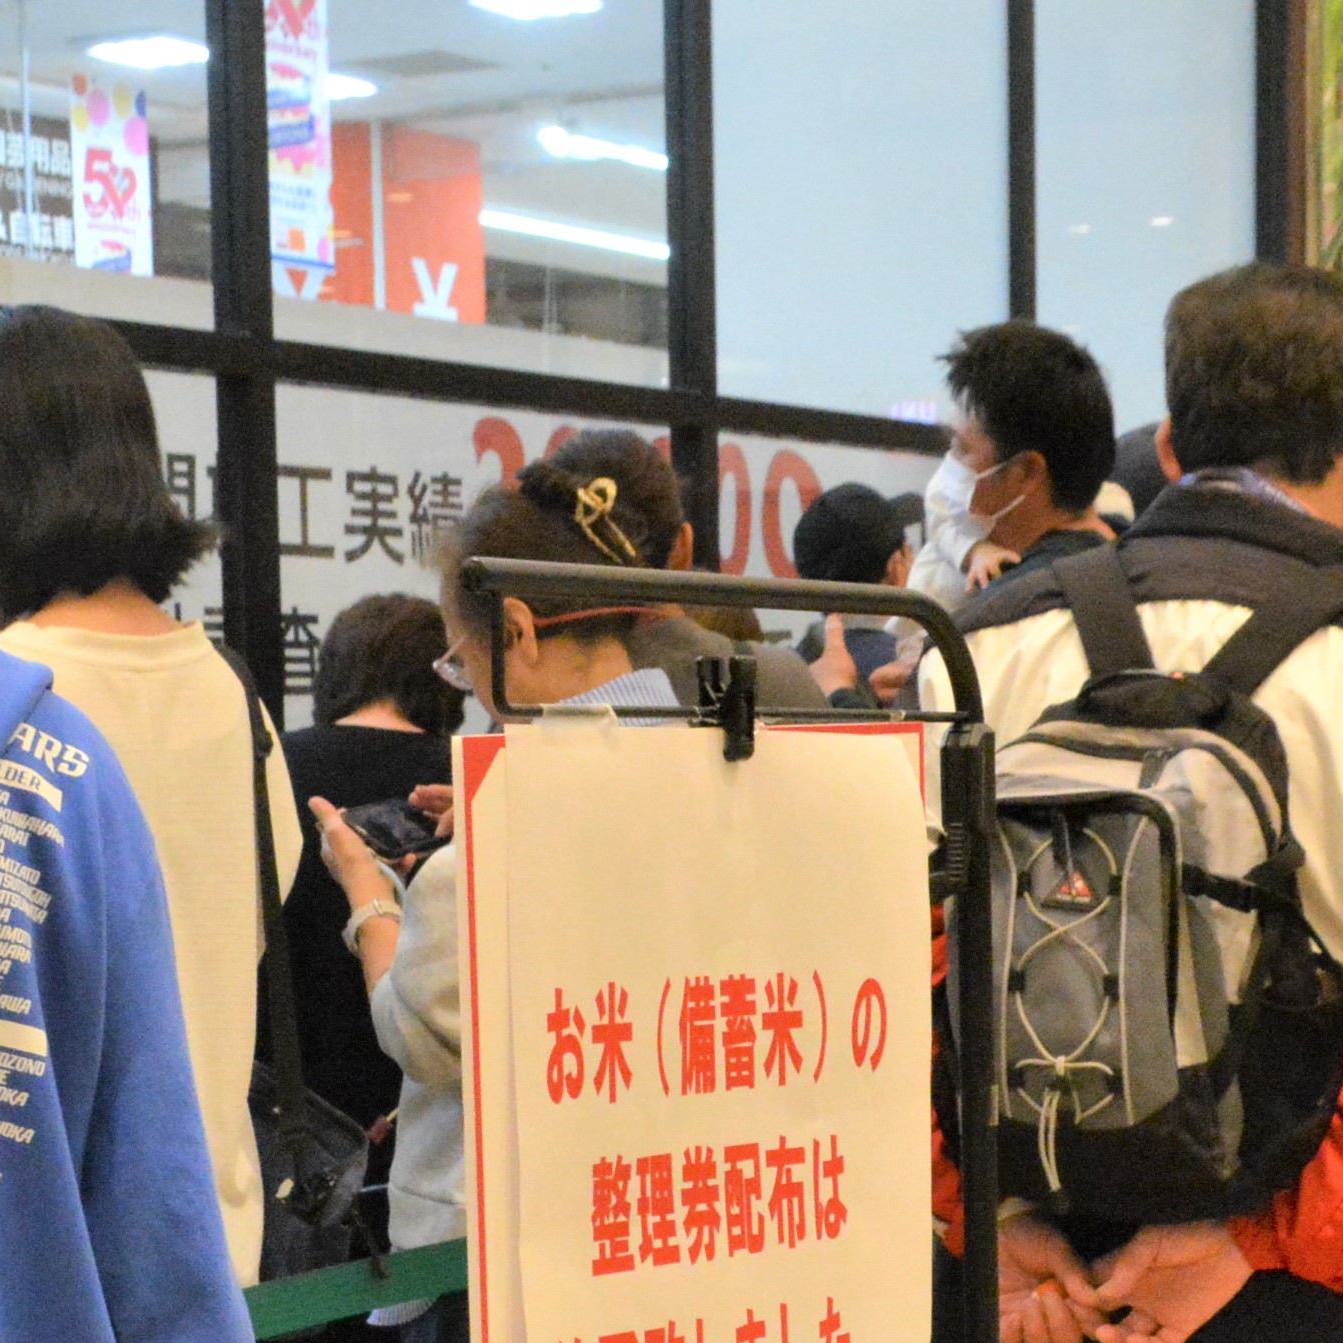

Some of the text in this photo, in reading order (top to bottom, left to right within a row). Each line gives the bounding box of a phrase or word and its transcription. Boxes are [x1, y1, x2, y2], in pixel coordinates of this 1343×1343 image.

[591, 1134, 848, 1277] 整理券配布は
